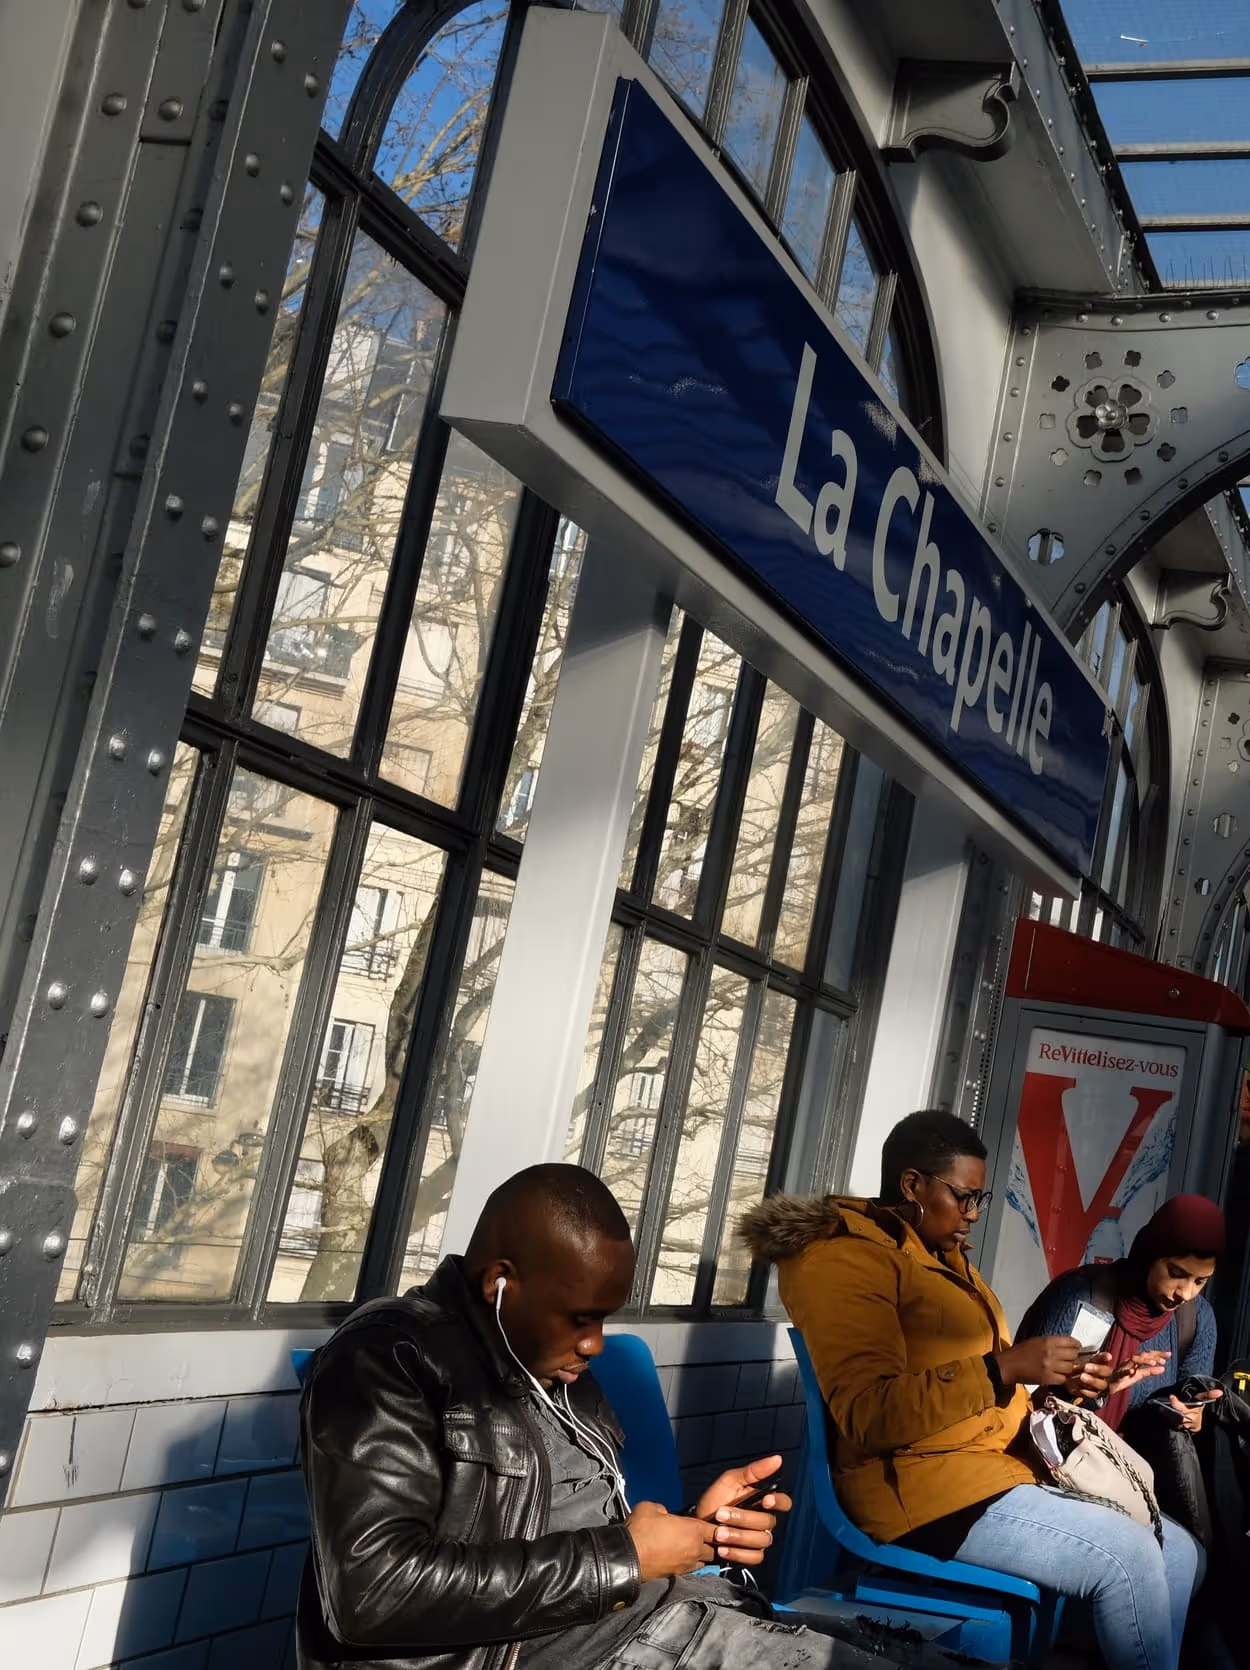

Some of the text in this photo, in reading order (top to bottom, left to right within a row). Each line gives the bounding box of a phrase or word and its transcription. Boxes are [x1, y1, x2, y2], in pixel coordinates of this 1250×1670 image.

[775, 341, 1053, 775] La Chapelle
[1038, 1043, 1179, 1078] ReVittelisez-vous
